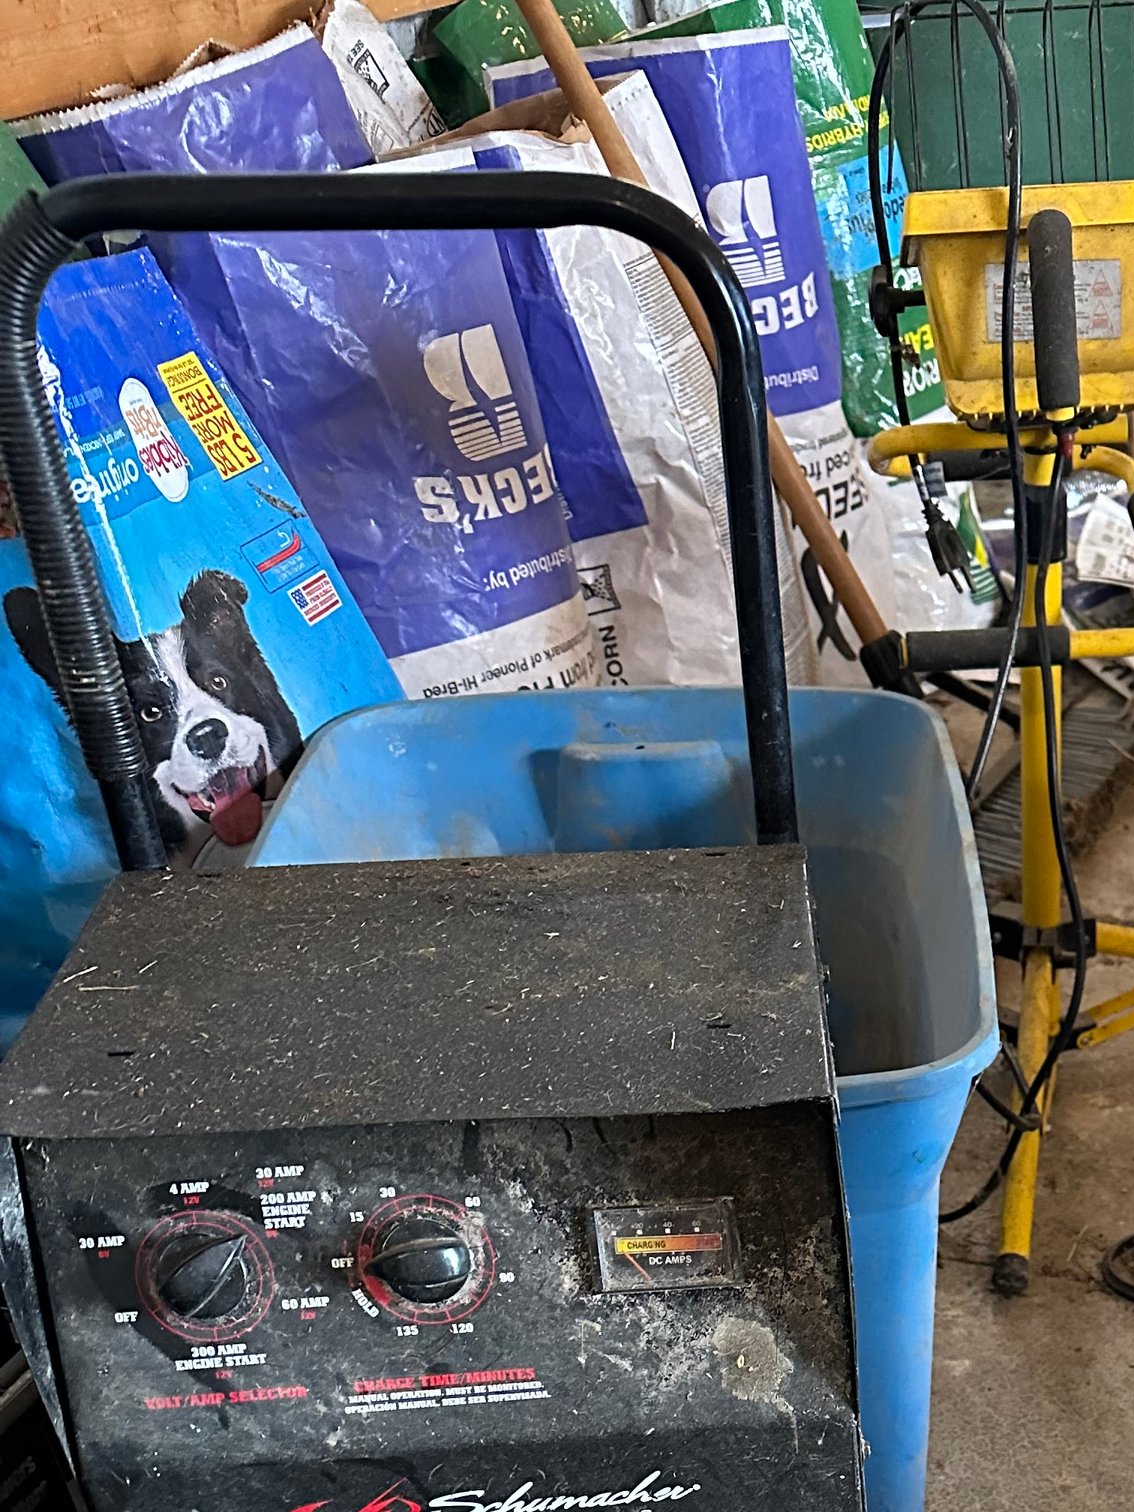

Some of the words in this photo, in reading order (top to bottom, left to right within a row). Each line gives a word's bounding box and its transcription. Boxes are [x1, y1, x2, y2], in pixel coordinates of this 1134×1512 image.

[806, 123, 863, 152] HYBRIDS
[751, 272, 819, 336] BEC
[178, 384, 223, 421] FREE
[192, 411, 235, 443] MORE
[139, 431, 190, 478] Kibbles
[232, 432, 257, 464] 5
[207, 440, 245, 476] LBS
[484, 573, 507, 592] by:
[481, 660, 530, 684] Pioneer
[255, 1168, 272, 1179] 30
[274, 1165, 305, 1178] AMP
[169, 1183, 178, 1194] 4
[180, 1181, 210, 1194] AMP
[379, 1187, 396, 1198] 30
[183, 1196, 200, 1205] 12V
[260, 1193, 285, 1205] 200
[287, 1191, 317, 1203] AMP
[464, 1196, 481, 1207] 60
[262, 1204, 310, 1217] ENGINE
[349, 1211, 364, 1223] 15
[264, 1217, 307, 1230] START
[79, 1238, 95, 1249] 30
[98, 1236, 126, 1248] AMP
[331, 1257, 355, 1269] OFF
[649, 1256, 662, 1265] DC
[665, 1255, 692, 1265] AMPS
[499, 1272, 516, 1283] 90
[281, 1298, 298, 1310] 60
[300, 1296, 330, 1309] AMP
[351, 1288, 380, 1318] HOLD
[114, 1311, 139, 1323] OFF
[396, 1324, 419, 1337] 135
[452, 1322, 474, 1334] 120
[191, 1346, 216, 1358] 300
[217, 1343, 248, 1356] AMP
[175, 1357, 224, 1371] ENGINE
[226, 1353, 267, 1367] START
[353, 1375, 416, 1393] CHARGE
[419, 1368, 536, 1388] TIME/MINUTES
[146, 1392, 225, 1409] VOLT/AMP
[229, 1384, 307, 1404] SELECTOR
[348, 1392, 389, 1404] MANUAL
[445, 1386, 472, 1396] MUST
[474, 1384, 487, 1394] BE
[488, 1380, 545, 1392] MONITORED.
[344, 1401, 397, 1414] OPERACIÓN
[442, 1396, 467, 1407] DEBE
[468, 1394, 487, 1404] SER
